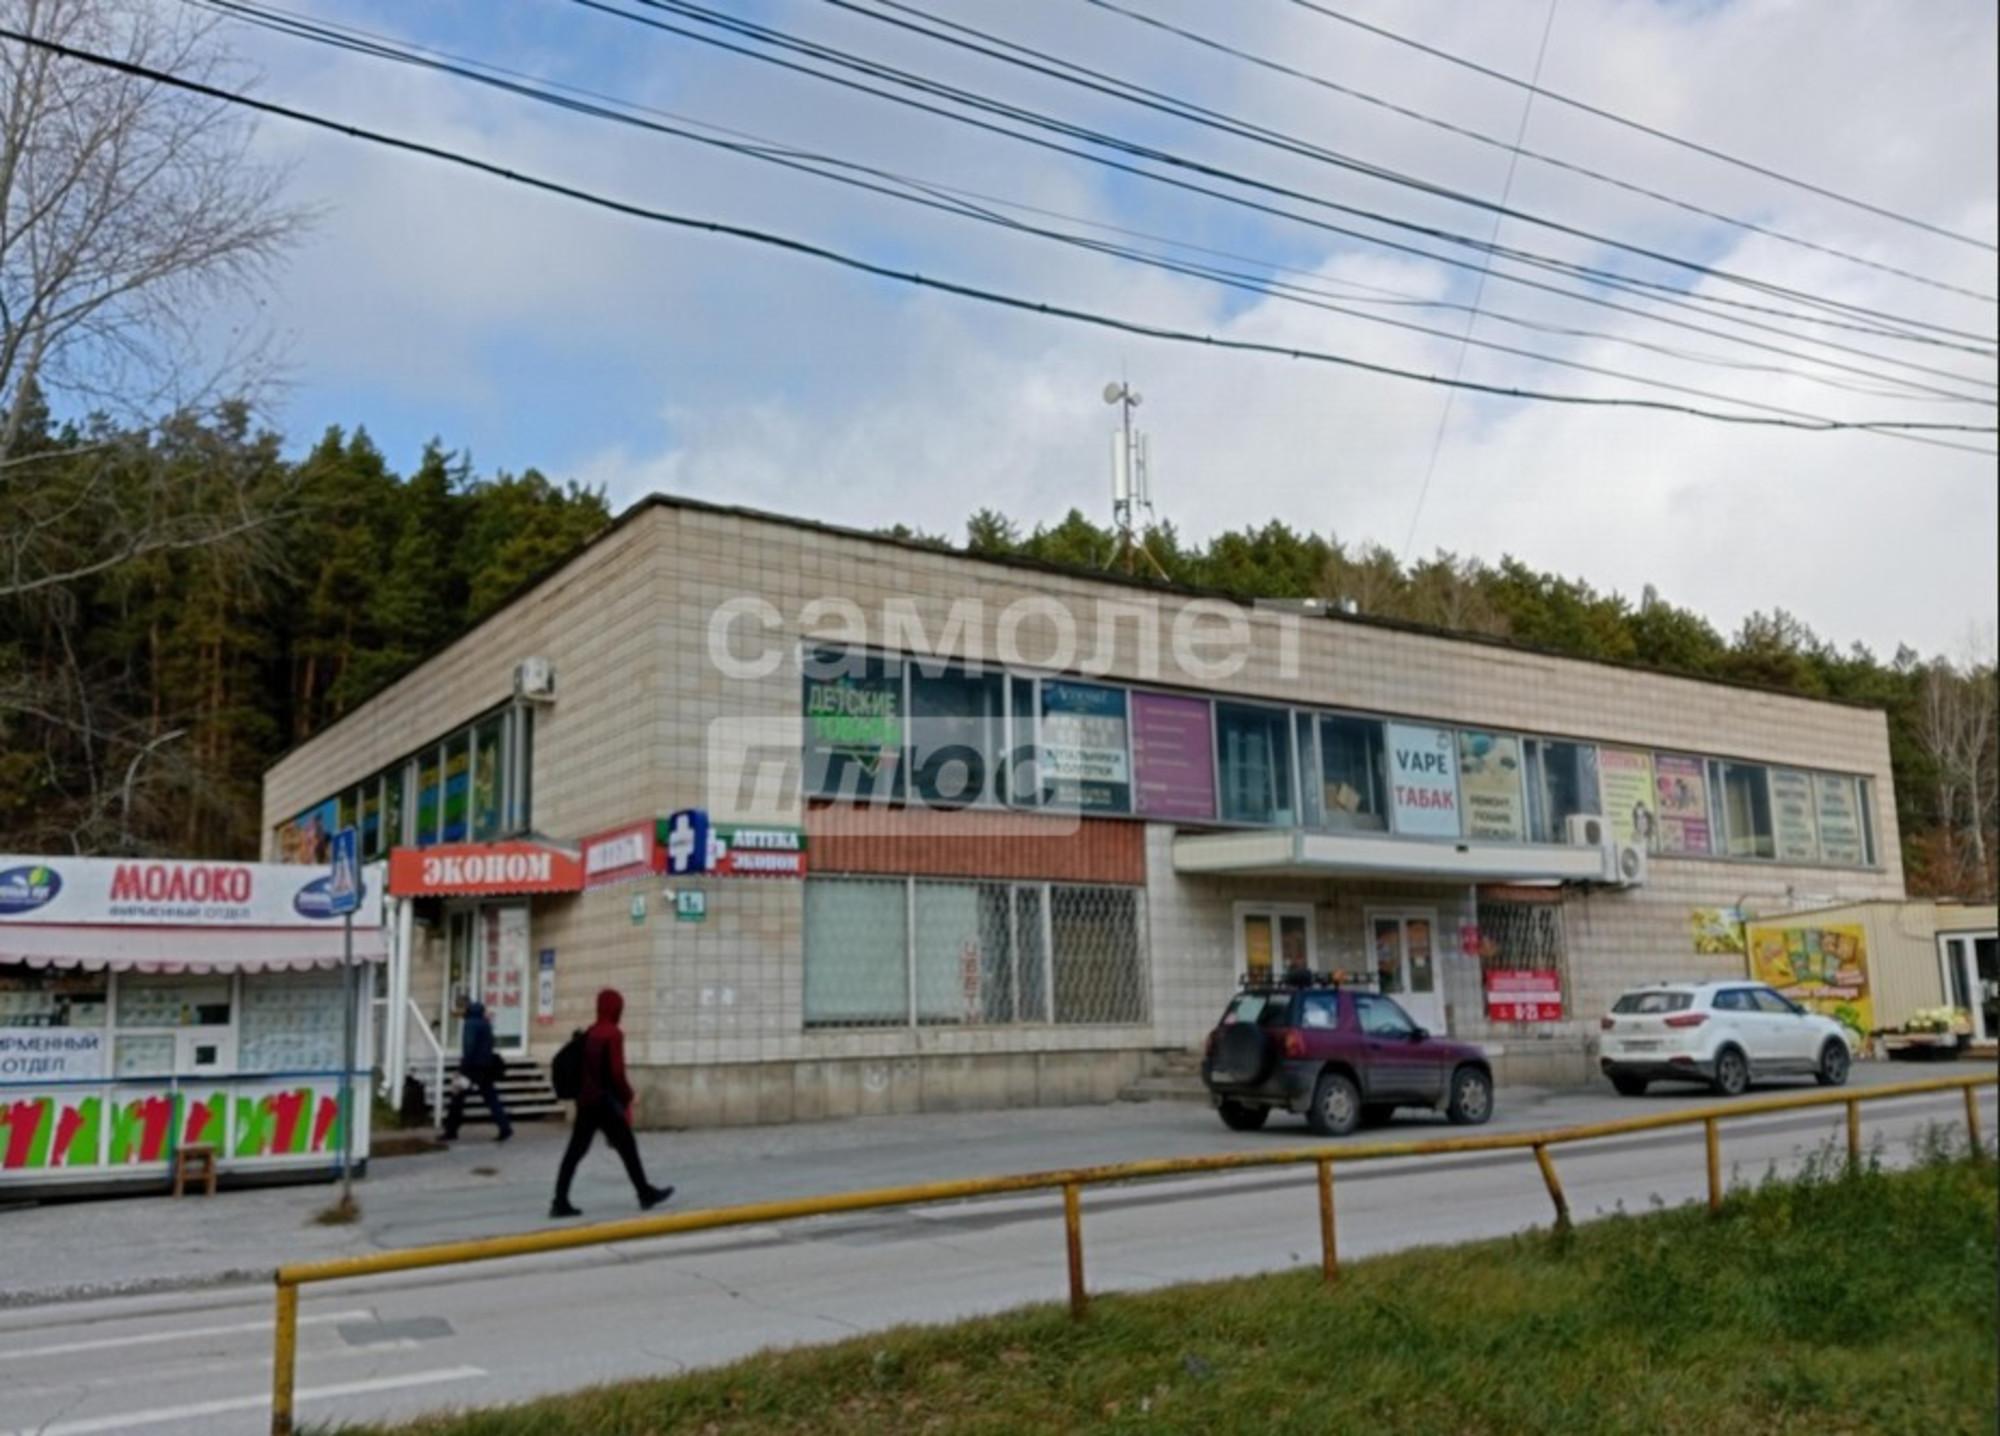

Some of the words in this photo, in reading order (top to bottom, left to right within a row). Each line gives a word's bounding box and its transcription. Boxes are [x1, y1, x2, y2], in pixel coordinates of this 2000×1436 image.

[807, 685, 897, 720] ДЕТСКИЕ
[1396, 749, 1449, 775] VAPE
[1395, 786, 1454, 811] ТАБАК
[731, 830, 799, 849] АПТЕКА
[423, 853, 552, 886] ЭКОНОМ
[731, 851, 799, 871] ЭКОНОМ
[110, 864, 252, 902] МОЛОКО
[2, 1057, 65, 1074] ОТДЕЛ
